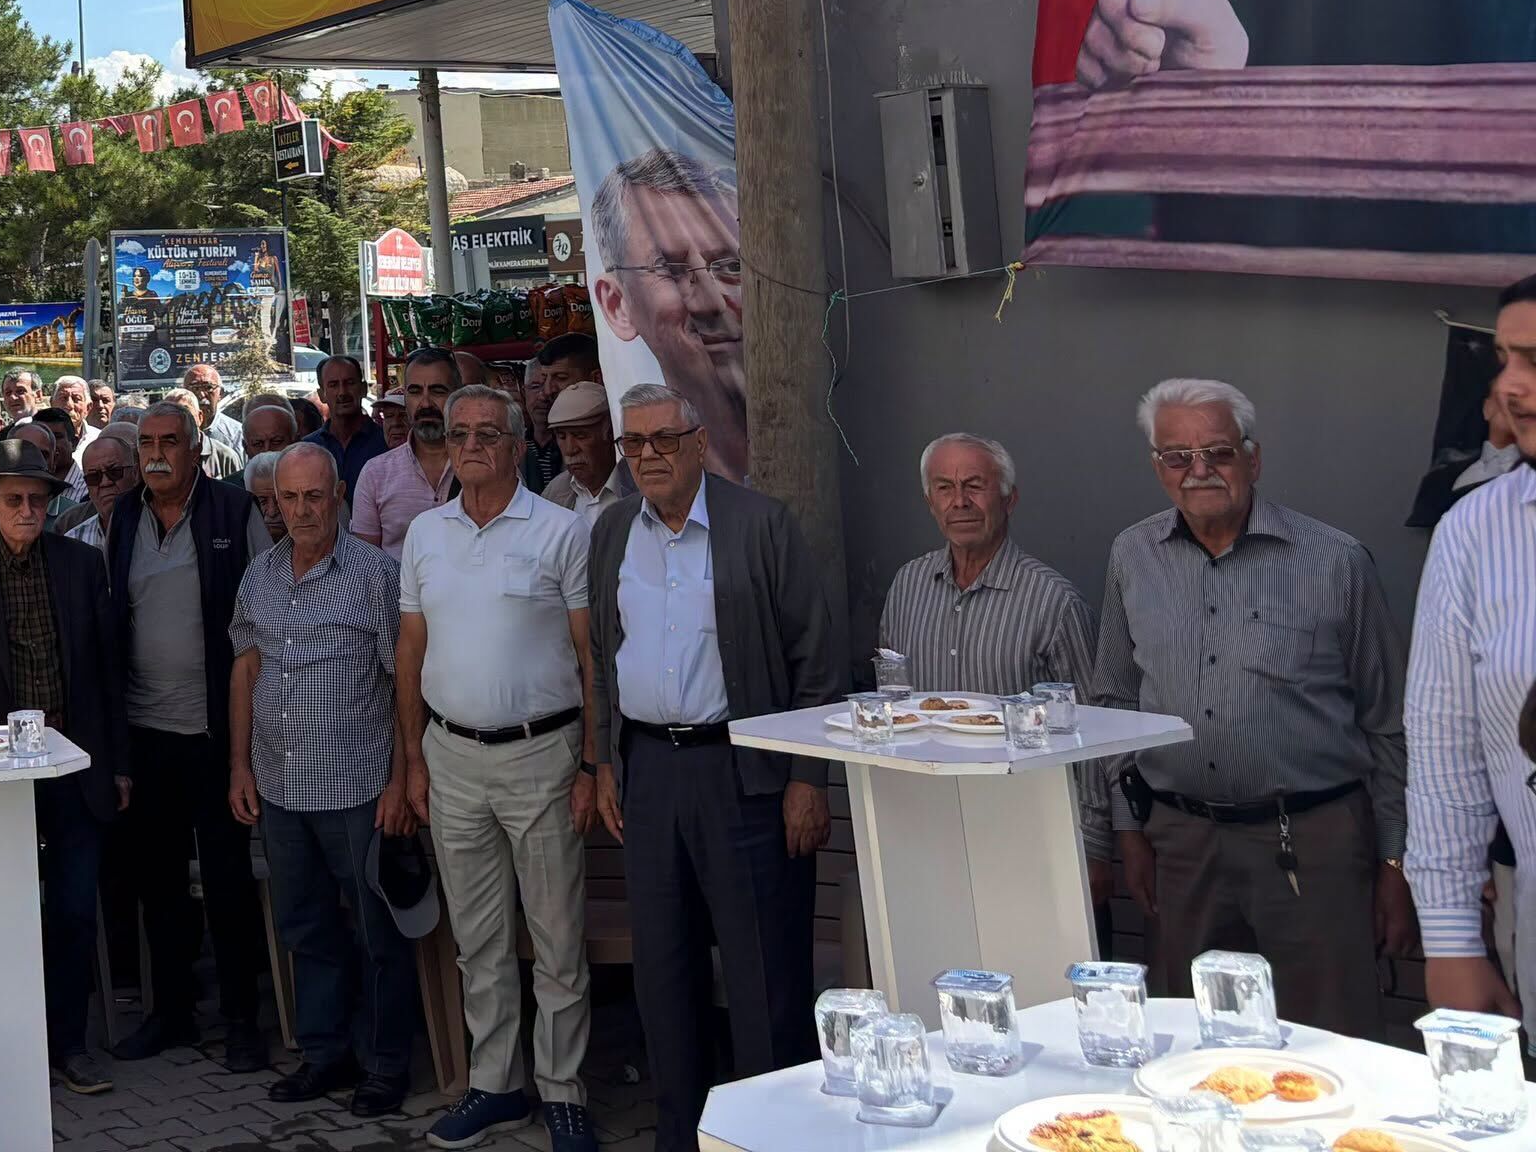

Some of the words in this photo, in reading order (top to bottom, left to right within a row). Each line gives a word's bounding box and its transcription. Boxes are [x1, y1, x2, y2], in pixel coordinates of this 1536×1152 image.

[165, 237, 219, 245] KEMERHİSAR
[471, 227, 533, 249] ELEKTRİK
[147, 245, 188, 259] KÜLTÜR
[189, 250, 198, 258] ve
[199, 244, 237, 257] TURİZM
[0, 318, 23, 327] KENTİ
